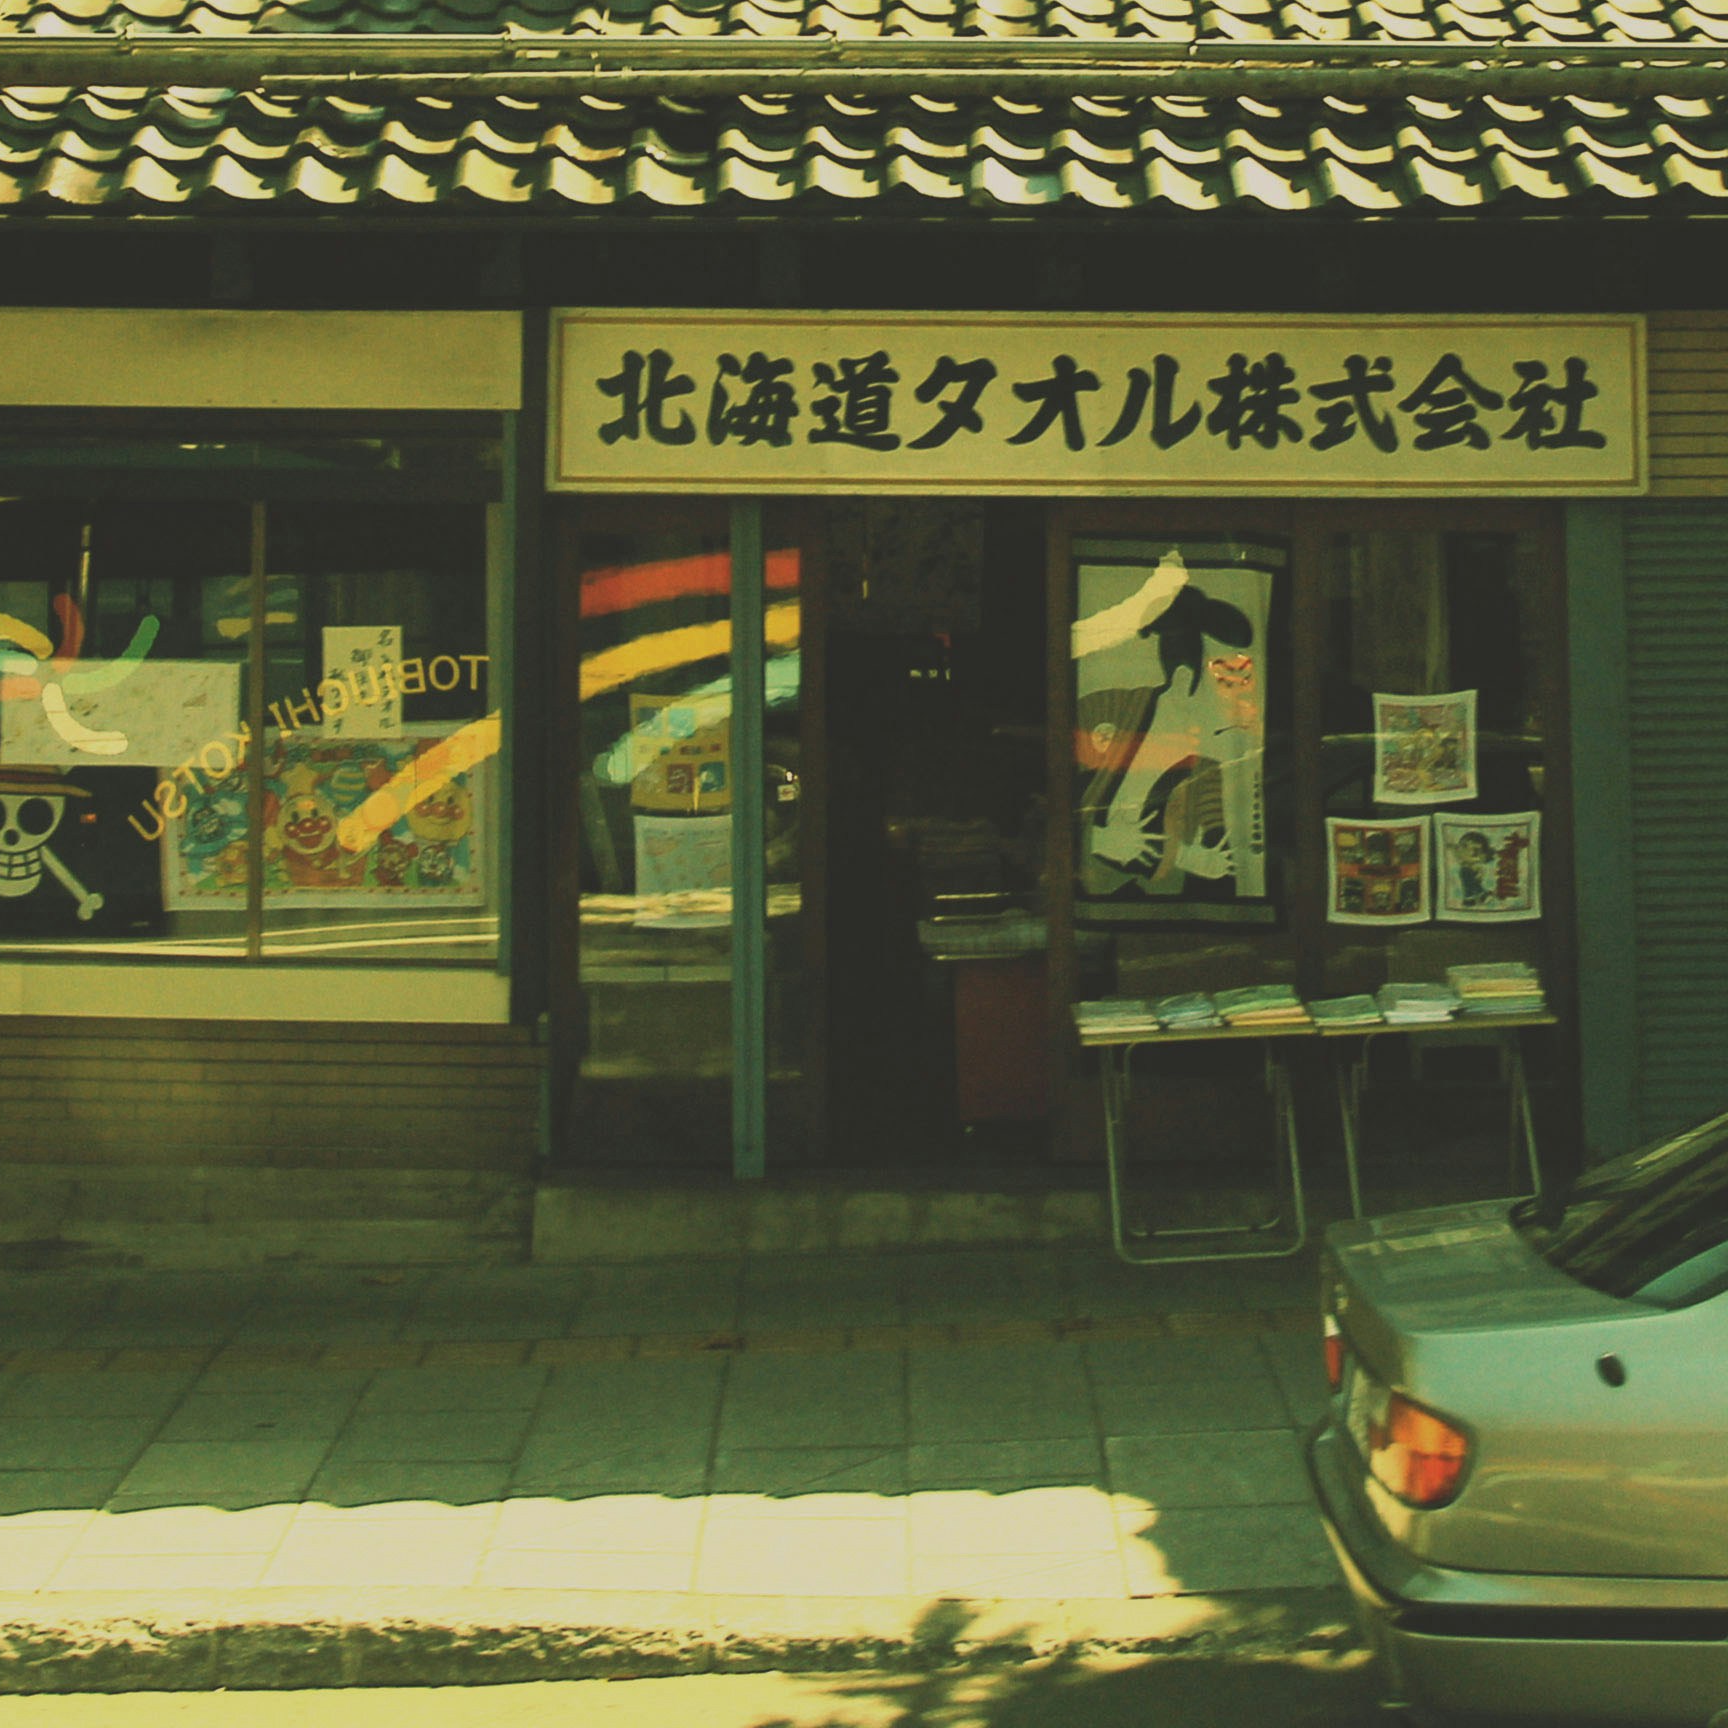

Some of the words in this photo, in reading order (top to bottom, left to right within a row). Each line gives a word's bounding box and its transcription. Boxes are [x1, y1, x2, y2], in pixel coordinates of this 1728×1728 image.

[595, 347, 1609, 452] 北海道タオル株式会社
